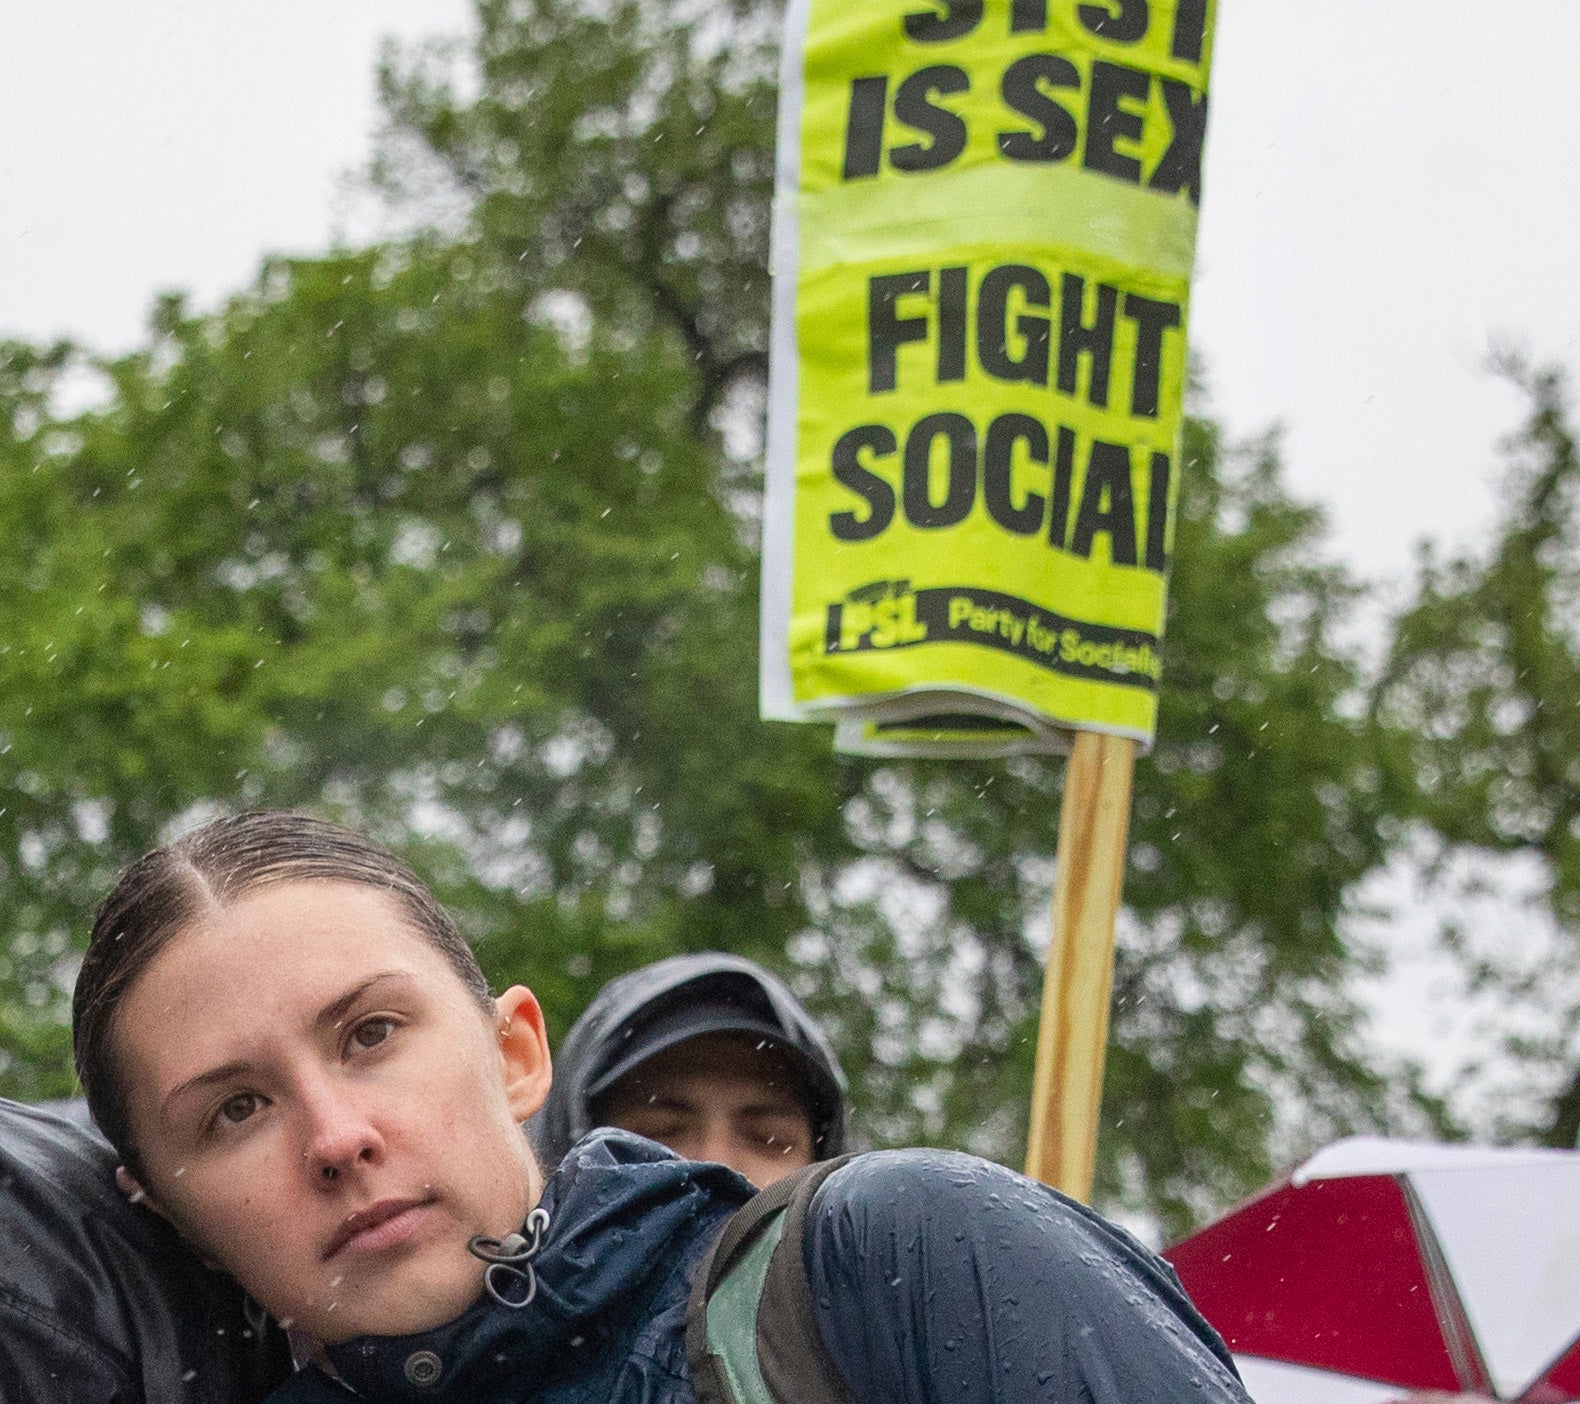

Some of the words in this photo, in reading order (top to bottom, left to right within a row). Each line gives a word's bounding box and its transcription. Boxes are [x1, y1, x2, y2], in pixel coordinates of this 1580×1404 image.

[842, 64, 970, 181] IS
[998, 52, 1208, 206] SEX
[868, 264, 1181, 419] FIGHT
[948, 597, 1025, 646] Party
[1026, 614, 1057, 655] for
